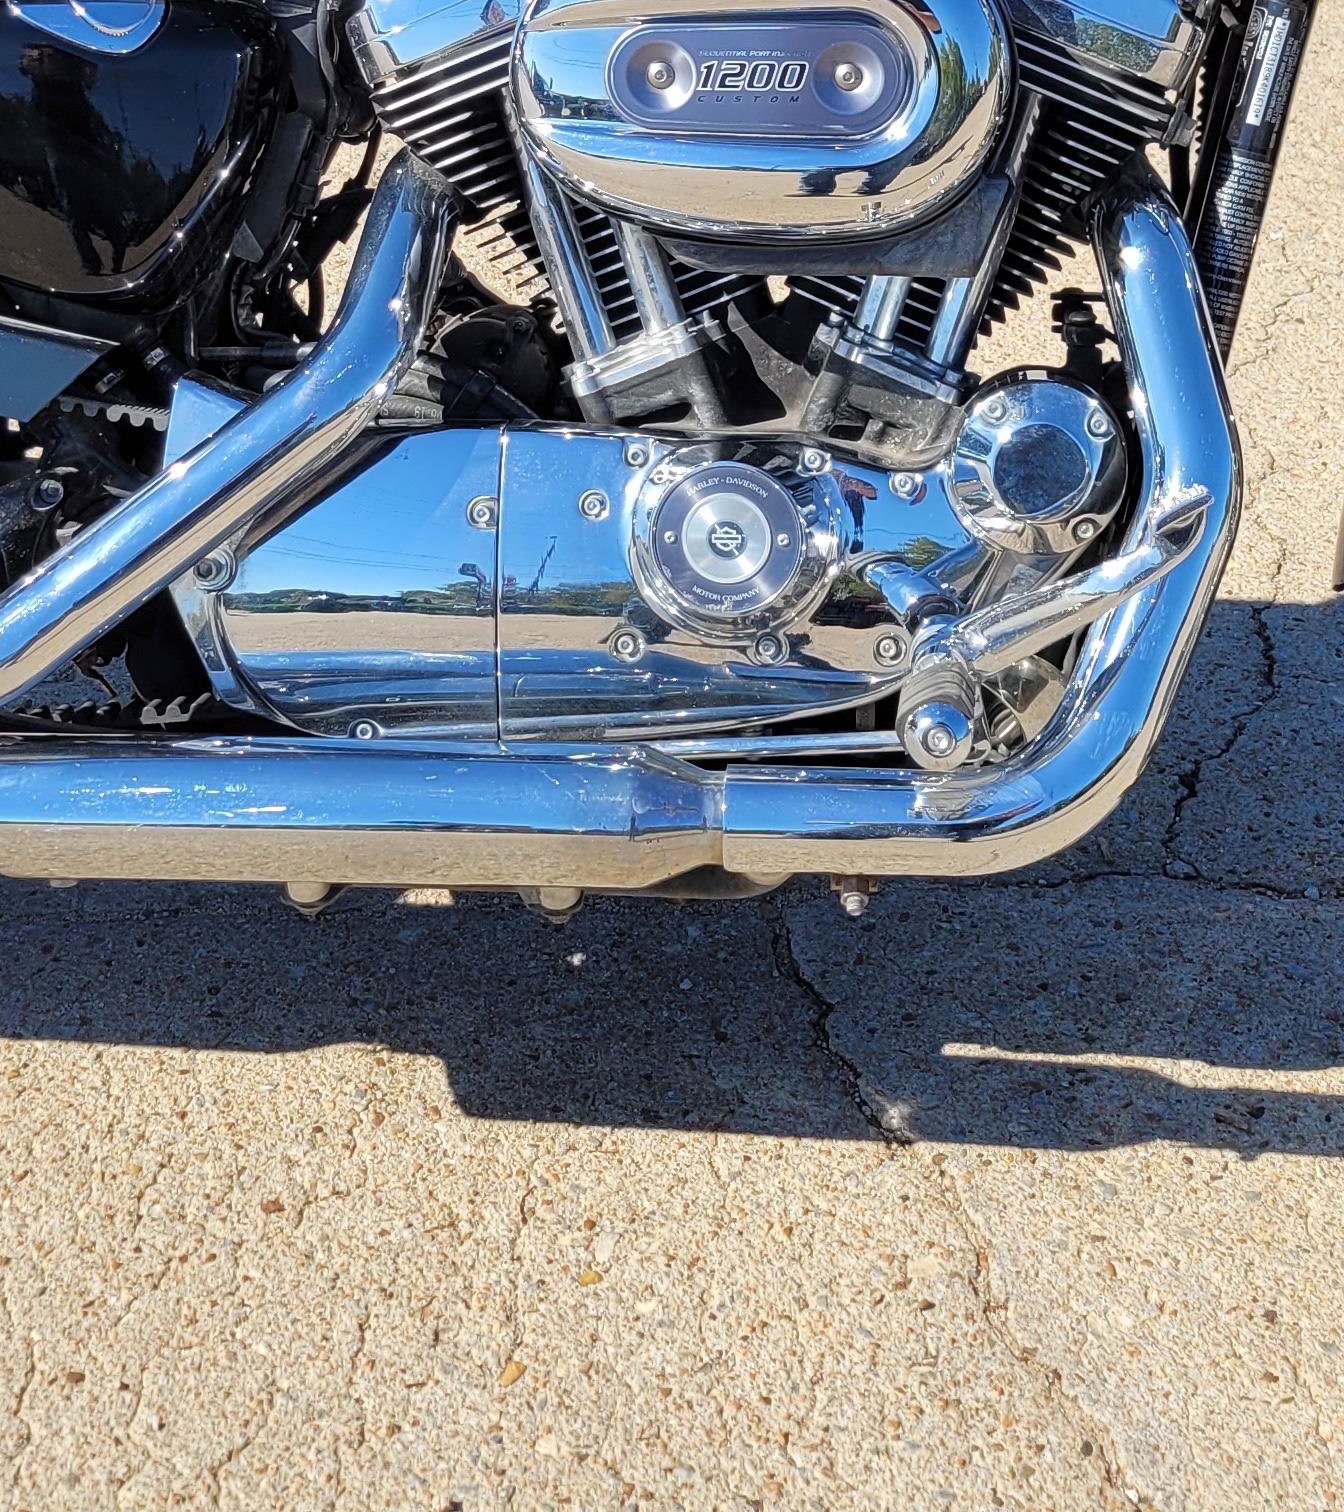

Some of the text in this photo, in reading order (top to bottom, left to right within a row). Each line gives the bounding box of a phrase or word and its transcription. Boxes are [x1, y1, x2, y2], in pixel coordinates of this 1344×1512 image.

[696, 61, 809, 91] 1200
[697, 95, 800, 103] CUSTOM
[686, 477, 720, 497] HARLEY
[726, 477, 769, 498] DAVIDSON
[692, 585, 760, 602] MOTOR COMPANY
